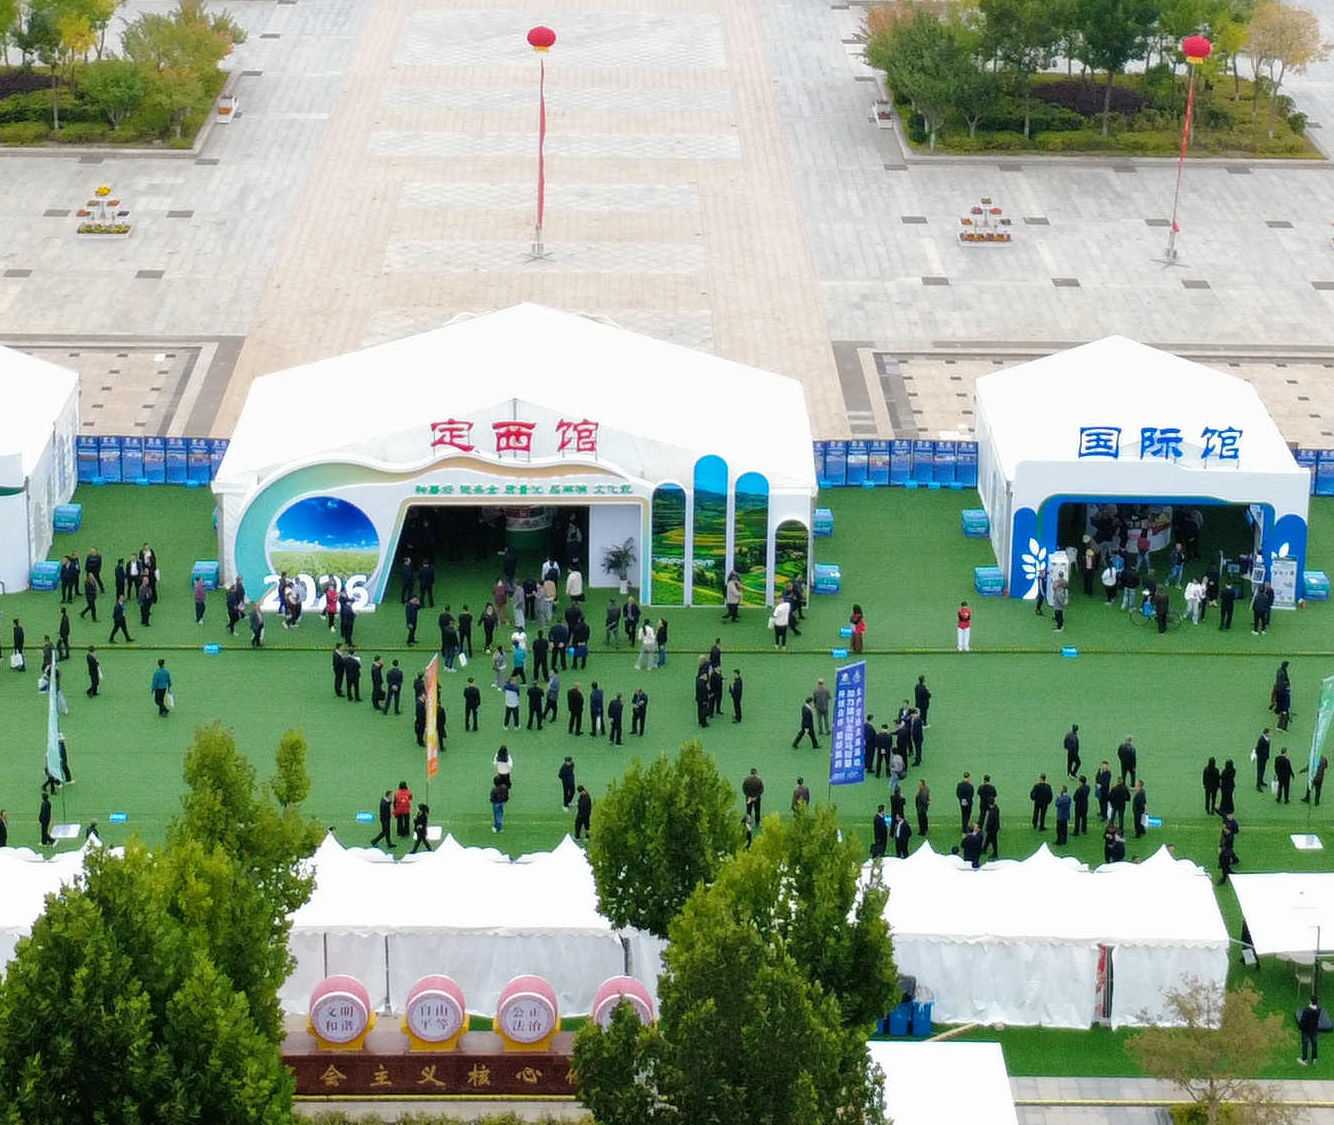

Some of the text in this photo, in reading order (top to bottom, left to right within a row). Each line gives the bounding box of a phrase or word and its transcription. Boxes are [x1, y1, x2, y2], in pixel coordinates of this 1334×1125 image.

[430, 418, 599, 452] 定西馆
[1078, 426, 1244, 460] 国际馆
[326, 1006, 354, 1018] 文明
[419, 1004, 449, 1017] 自由
[512, 1006, 539, 1018] 公正
[326, 1020, 355, 1032] 和谐
[420, 1018, 450, 1031] 平等
[512, 1020, 542, 1032] 法治
[286, 1064, 577, 1087] 会主义核心
